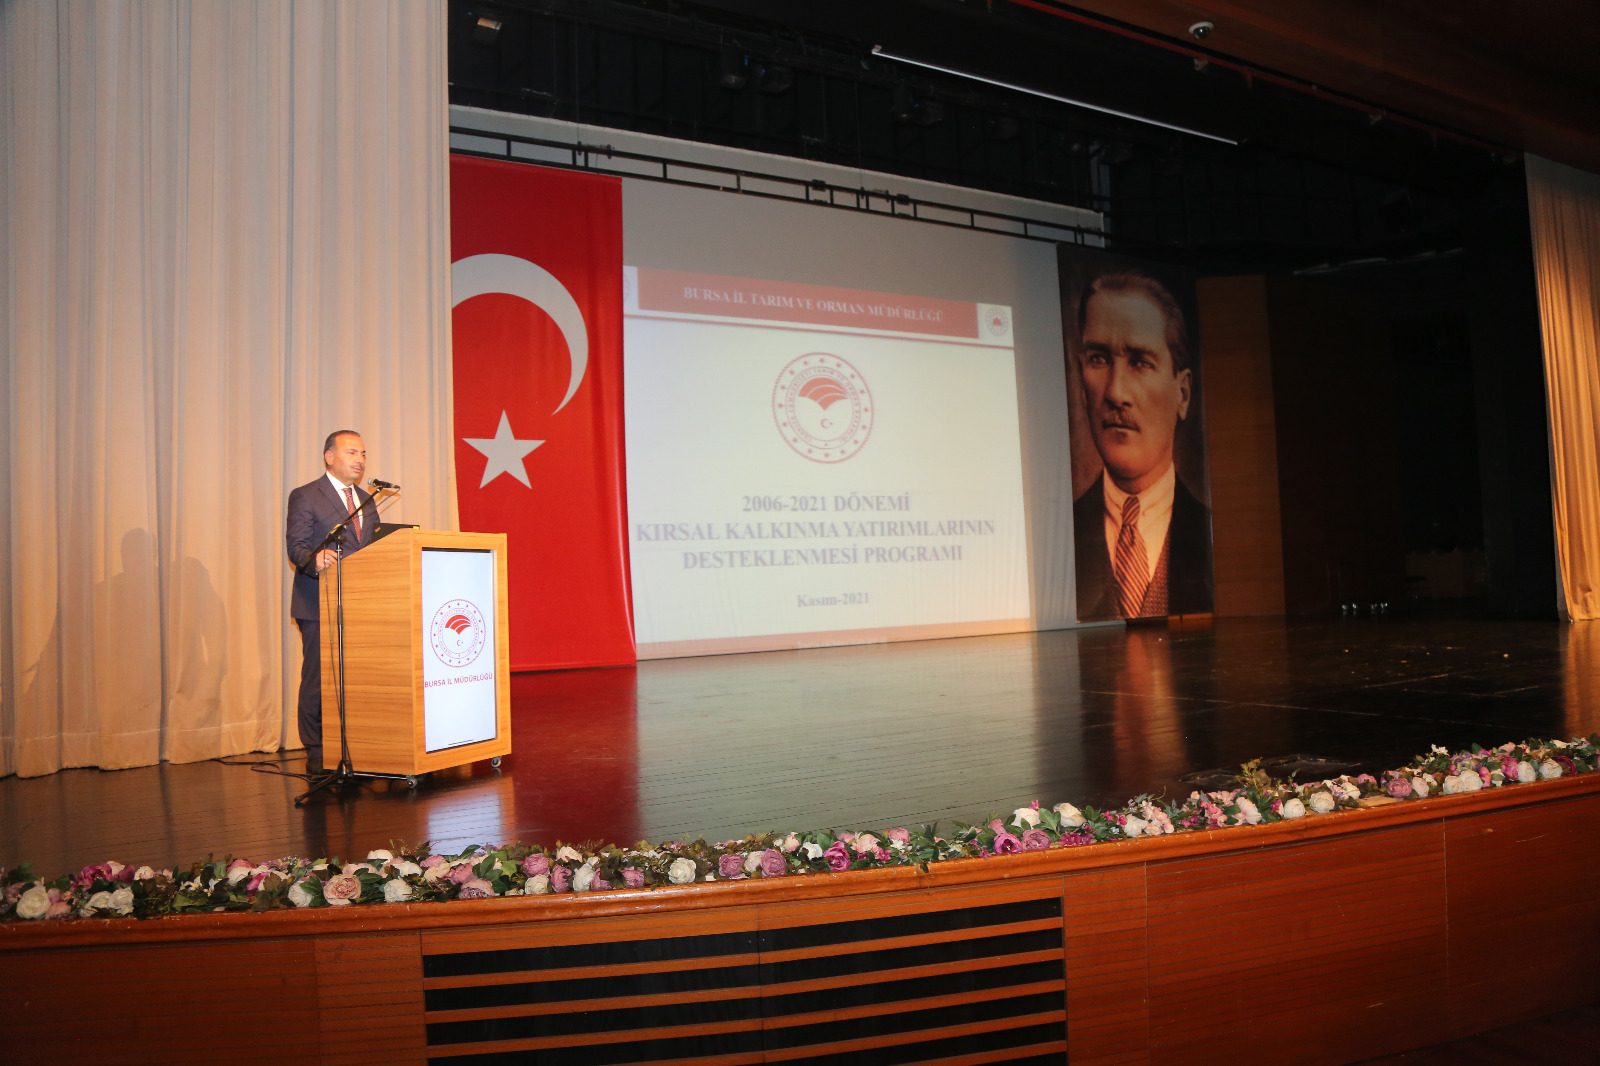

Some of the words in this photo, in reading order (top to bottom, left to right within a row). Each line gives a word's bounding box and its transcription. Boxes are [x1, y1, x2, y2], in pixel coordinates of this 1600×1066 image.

[683, 286, 730, 303] BURSA
[733, 289, 747, 305] İL
[750, 292, 794, 309] TARIM
[796, 297, 815, 311] VE
[816, 300, 865, 316] ORMAN
[741, 494, 828, 513] 2006-2021
[833, 491, 911, 513] DÖNEMİ
[635, 521, 720, 542] KIRSAL
[725, 522, 839, 541] KALKINMA
[843, 519, 995, 539] YATIRIMLARININ
[683, 545, 859, 569] DESTEKLENMESİ
[864, 544, 965, 563] PROGRAMI
[796, 591, 871, 608] Kasım-2021
[424, 679, 446, 688] BURSA
[454, 672, 493, 684] MÜDÜRLÜĞÜ
